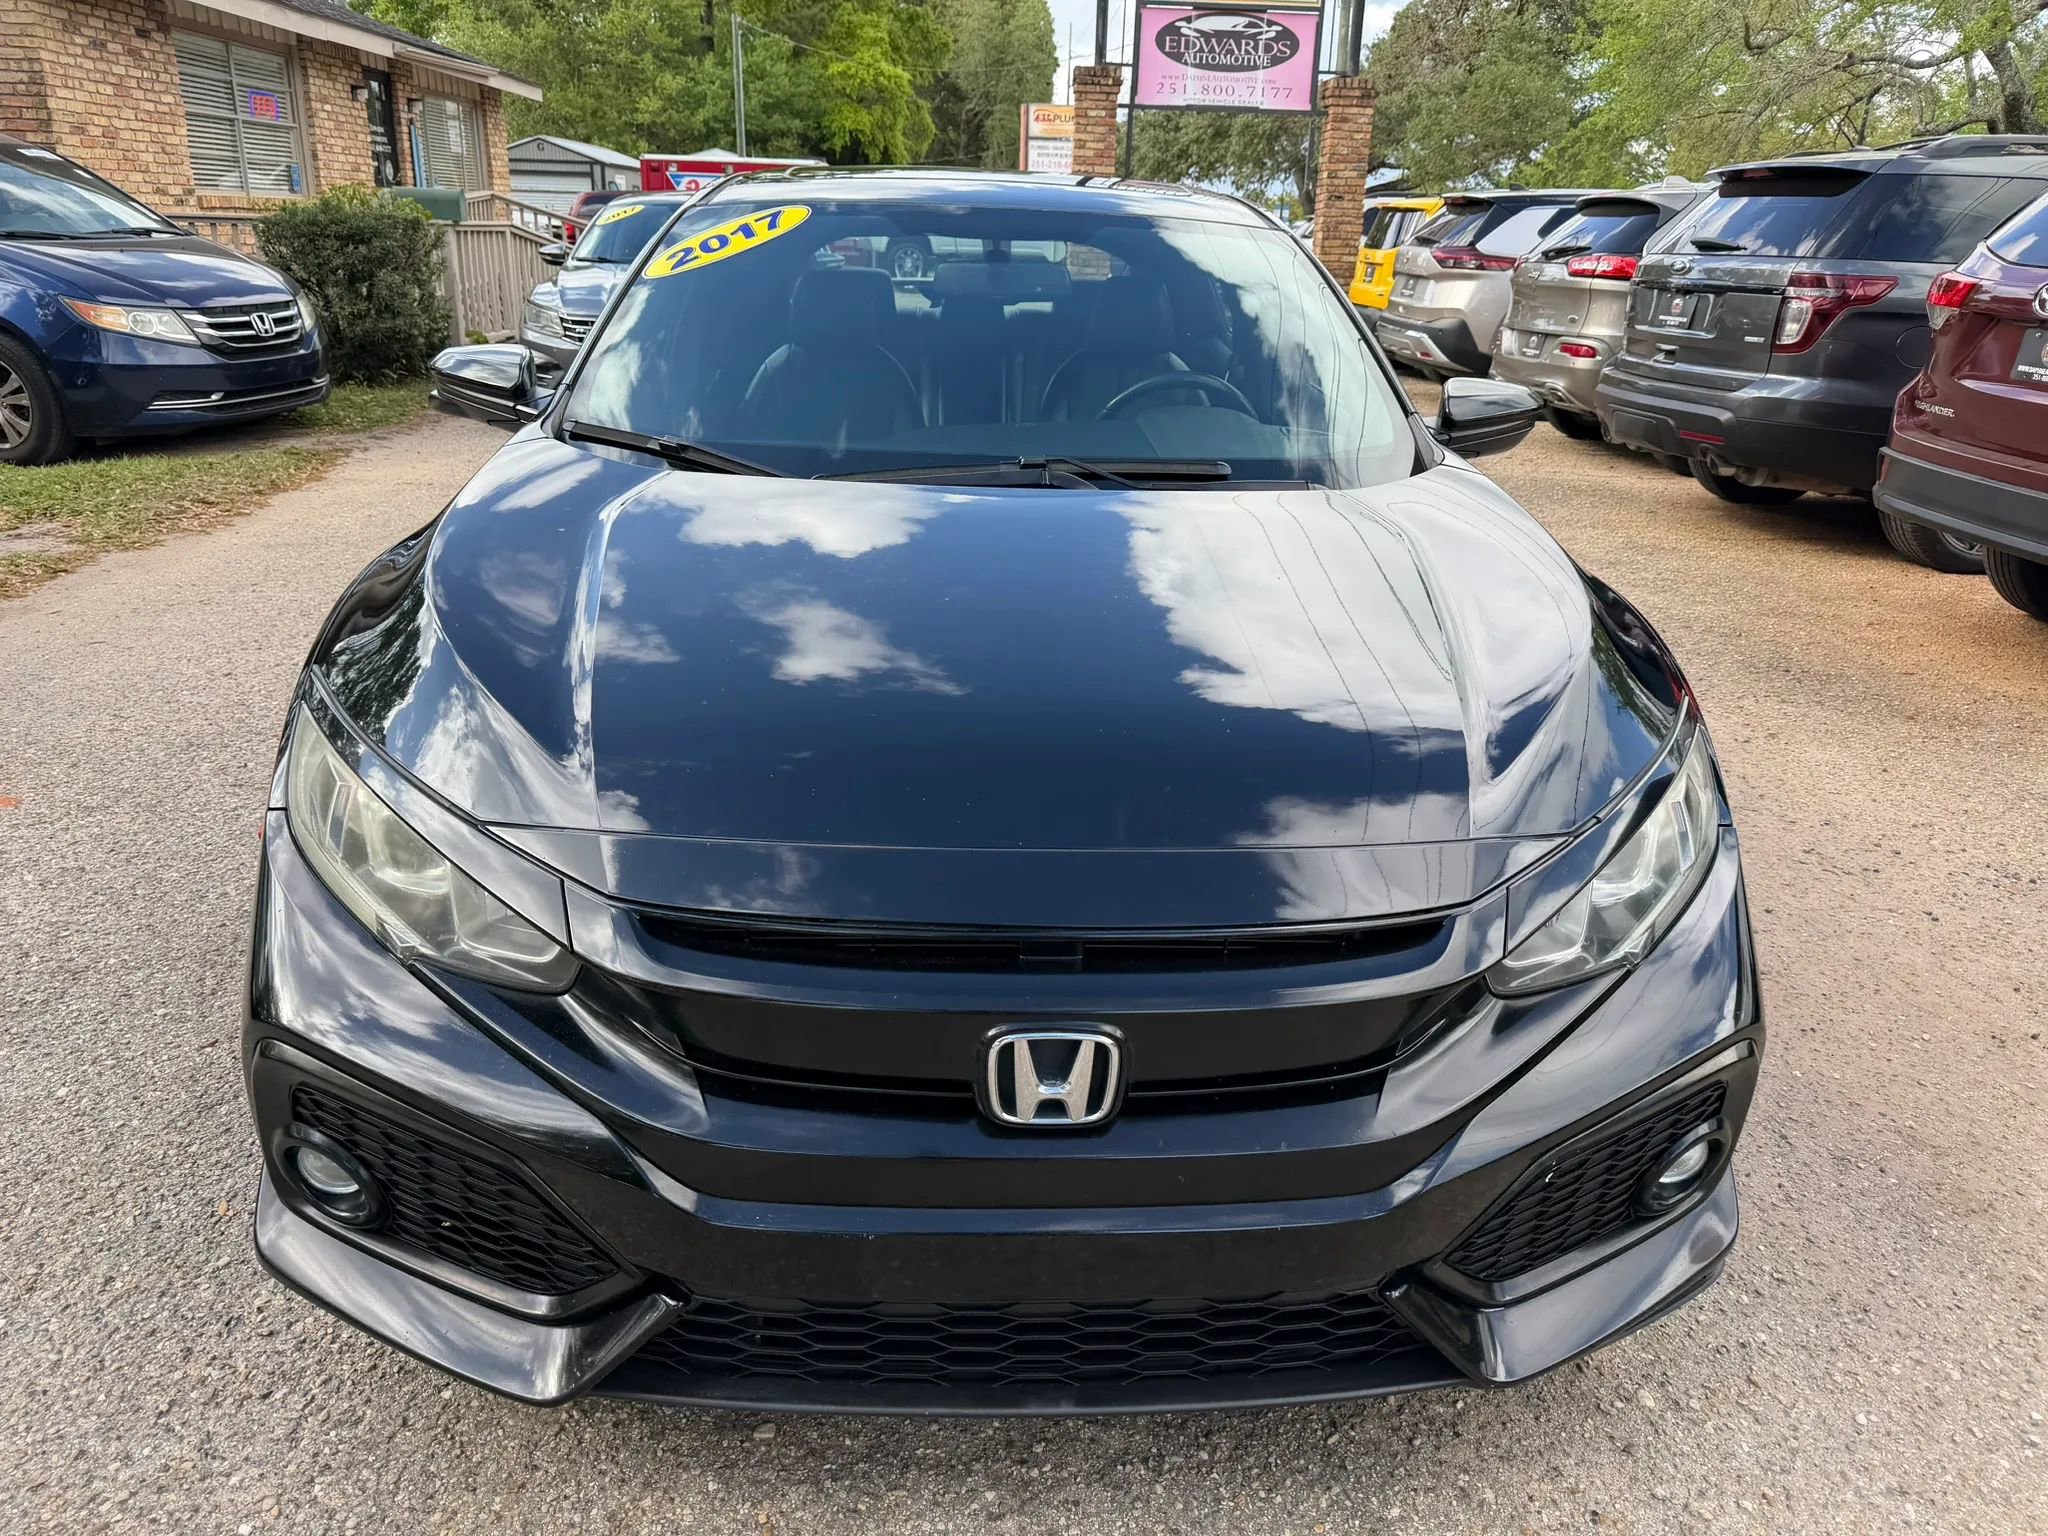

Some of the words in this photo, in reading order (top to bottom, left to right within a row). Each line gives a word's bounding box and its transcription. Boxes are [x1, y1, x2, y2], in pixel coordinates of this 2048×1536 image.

[1165, 36, 1291, 57] EDWARDS
[1181, 52, 1271, 66] AUTOMOTIVE
[1156, 82, 1293, 99] 251.800.7177
[1053, 113, 1074, 123] PLU
[666, 209, 784, 271] 2017
[1914, 399, 1955, 417] HIGHLANDER
